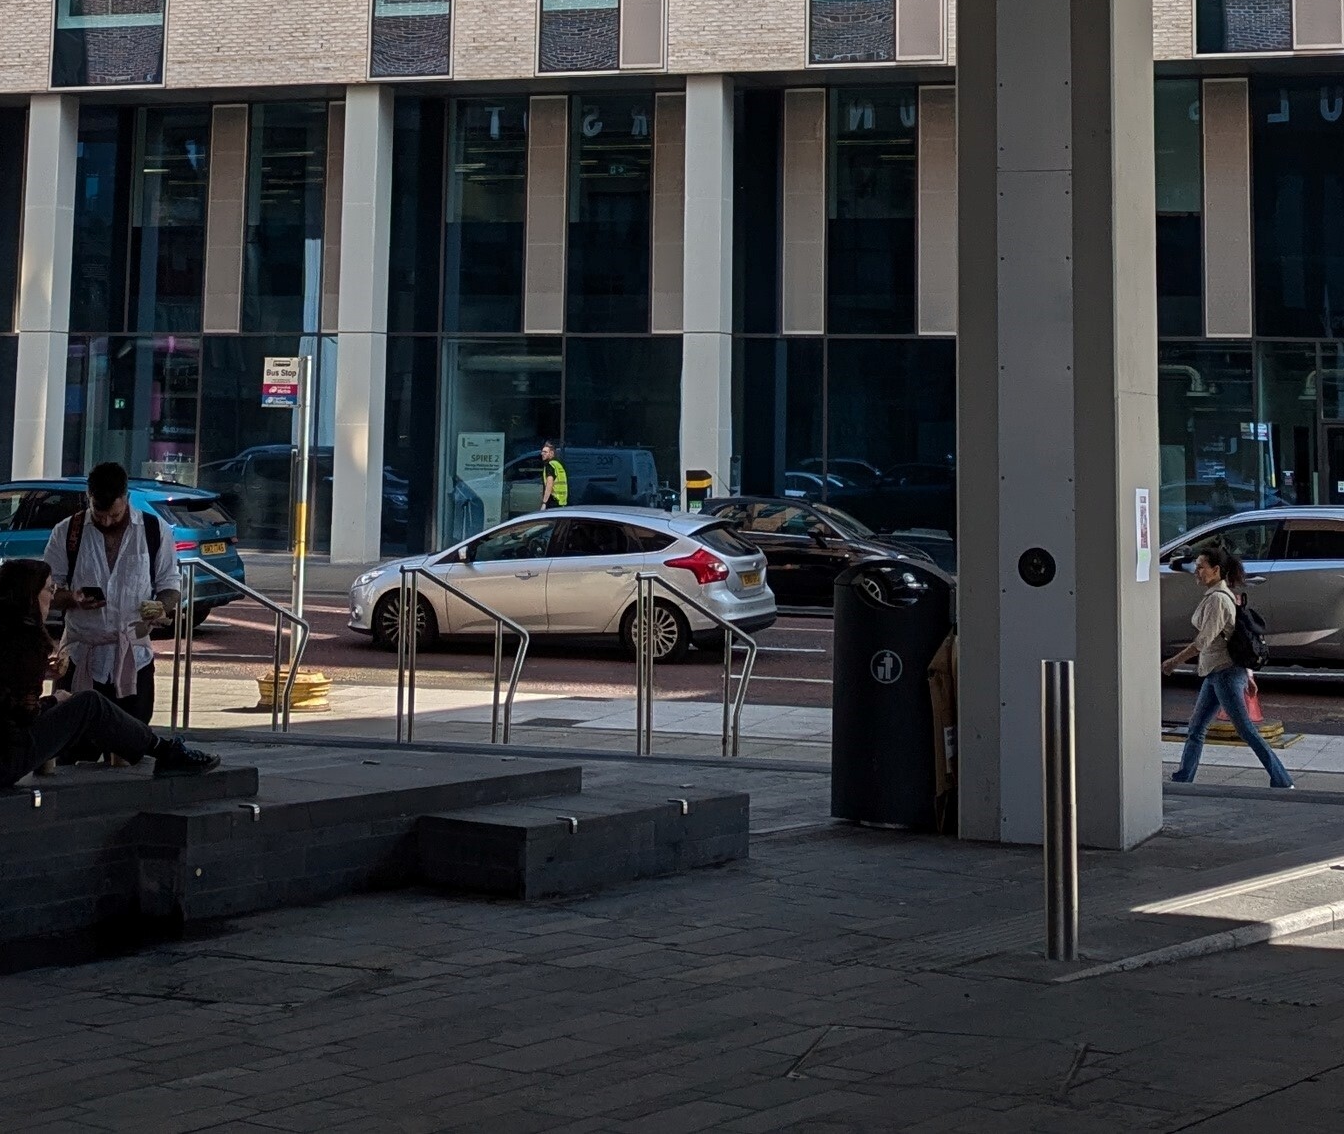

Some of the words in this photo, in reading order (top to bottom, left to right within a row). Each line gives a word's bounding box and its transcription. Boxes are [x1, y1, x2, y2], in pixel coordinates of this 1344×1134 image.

[281, 369, 296, 378] Stop
[471, 454, 493, 462] SPIRE
[494, 454, 499, 462] 2
